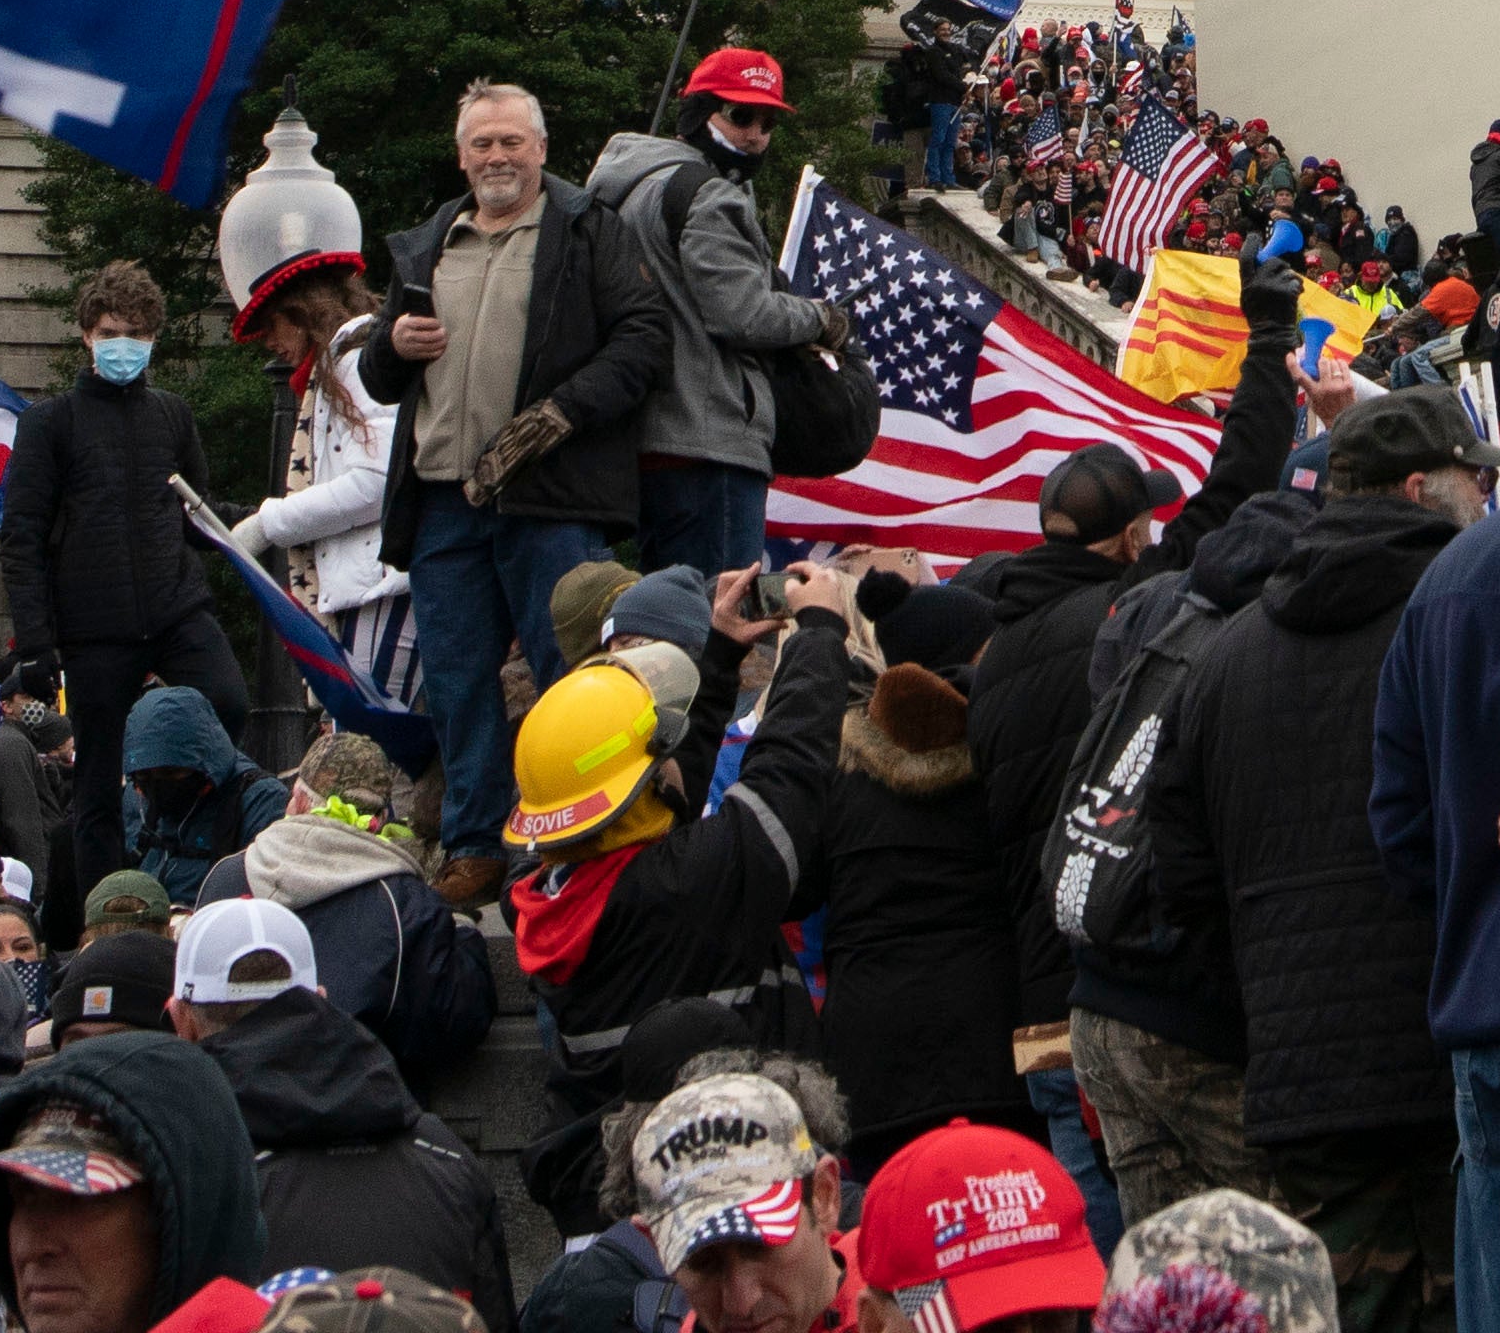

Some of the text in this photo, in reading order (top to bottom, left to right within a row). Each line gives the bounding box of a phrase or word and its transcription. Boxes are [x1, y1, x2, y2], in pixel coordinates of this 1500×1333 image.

[740, 67, 778, 84] TRUMP
[521, 805, 576, 836] SOVIE
[650, 1116, 769, 1172] TRUMP
[925, 1184, 1047, 1231] Trump
[985, 1205, 1028, 1233] 2020
